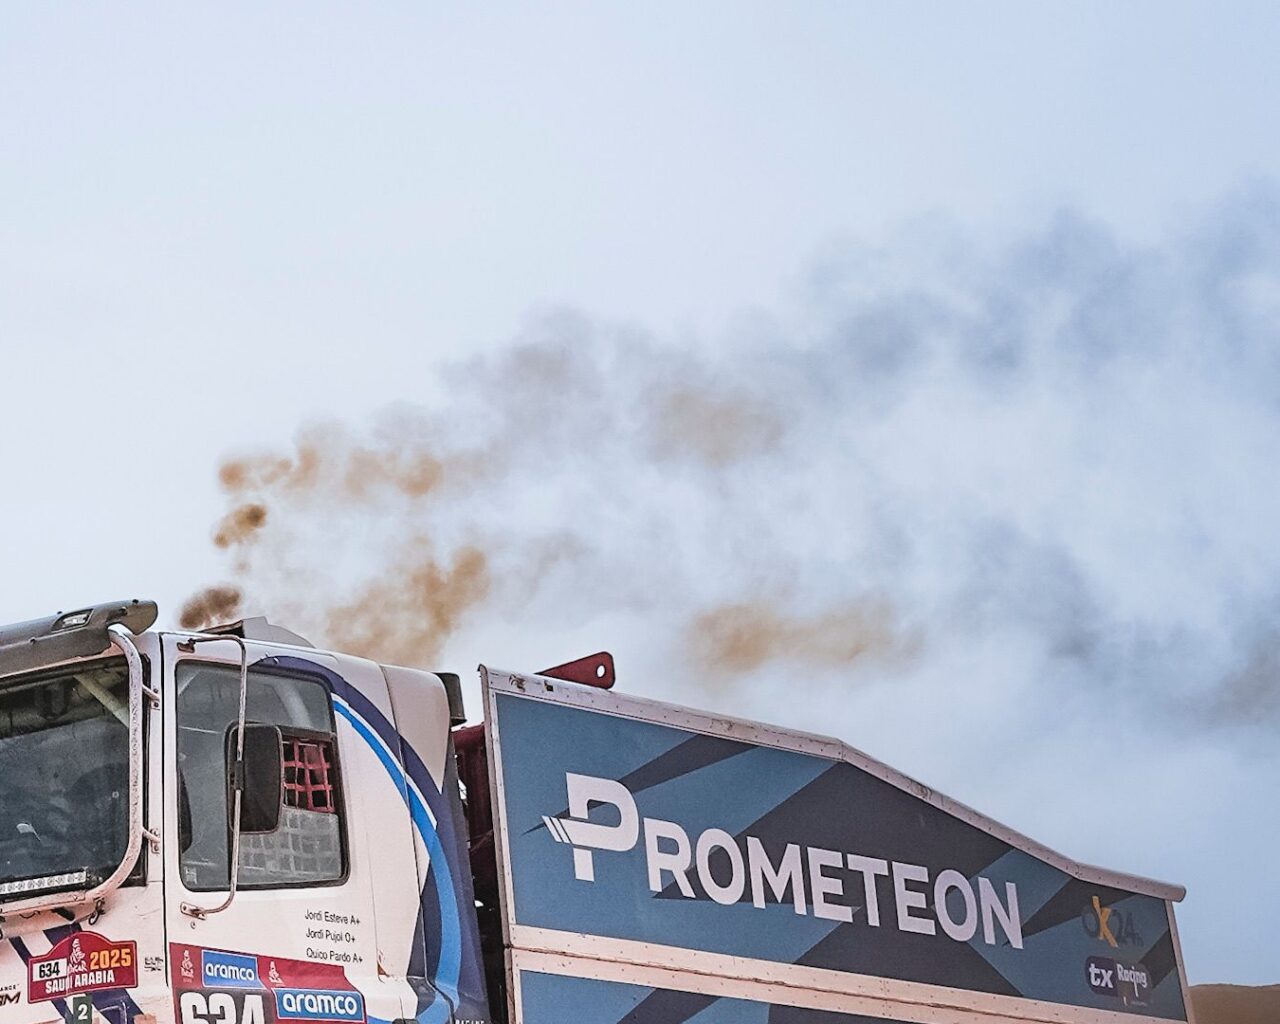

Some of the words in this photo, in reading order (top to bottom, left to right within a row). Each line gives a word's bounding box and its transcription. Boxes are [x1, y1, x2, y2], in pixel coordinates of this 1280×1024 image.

[542, 771, 1024, 949] PROMETEON
[305, 909, 322, 921] Jordi
[324, 911, 349, 924] Esteve
[306, 928, 324, 939] Jordi
[90, 948, 131, 970] 2025
[329, 950, 351, 962] Pardo
[39, 962, 60, 978] 634
[74, 970, 115, 988] ARABIA
[205, 963, 255, 981] aramco
[1089, 963, 1114, 988] tx
[78, 1004, 88, 1020] 2
[282, 994, 358, 1015] aramco
